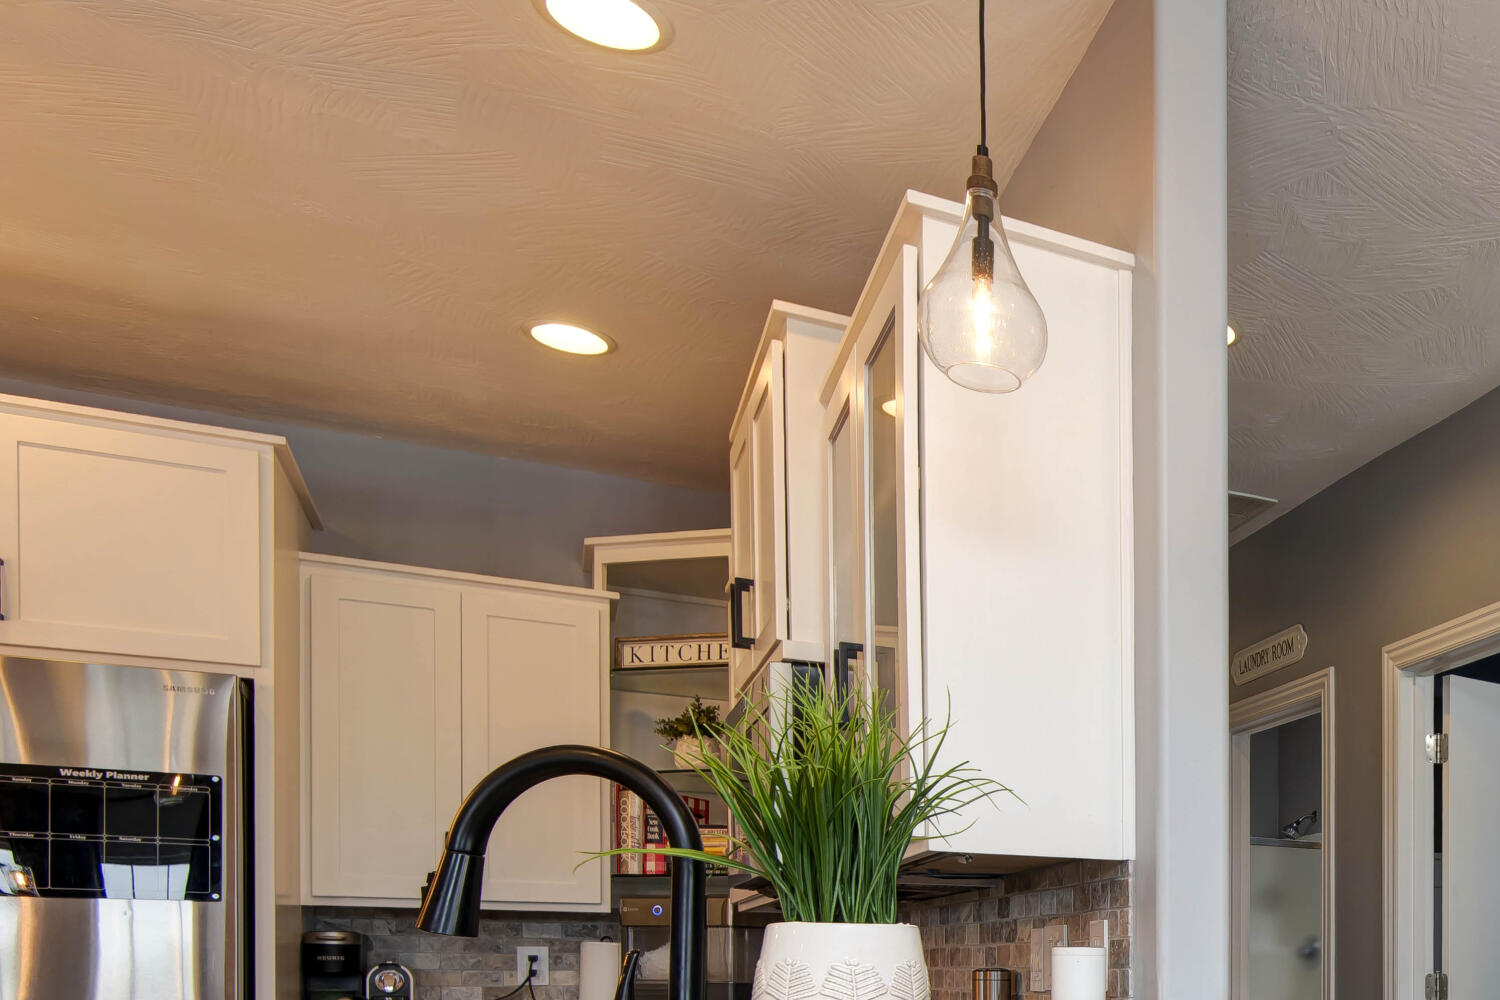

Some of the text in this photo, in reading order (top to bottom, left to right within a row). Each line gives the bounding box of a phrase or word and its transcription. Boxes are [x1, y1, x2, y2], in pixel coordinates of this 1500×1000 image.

[629, 643, 729, 663] KITCHE
[1239, 637, 1294, 675] LAUNDRY ROOM
[59, 768, 150, 781] Weekly Planner
[620, 798, 628, 862] COOKBOK
